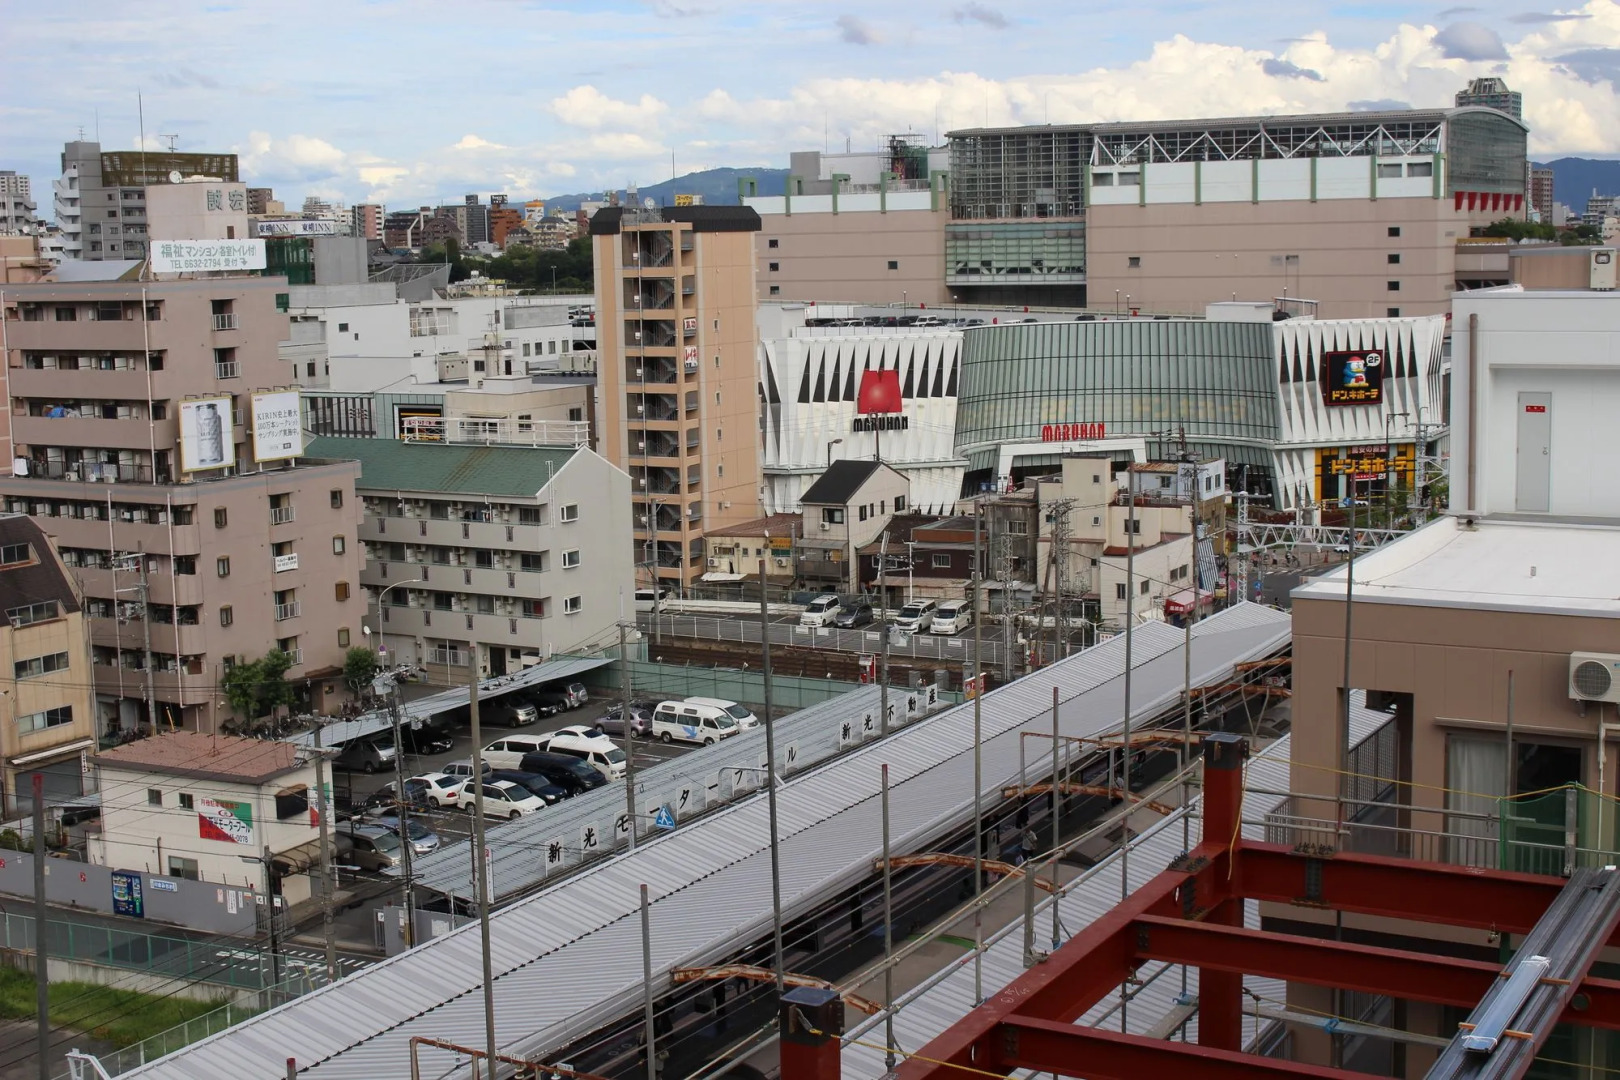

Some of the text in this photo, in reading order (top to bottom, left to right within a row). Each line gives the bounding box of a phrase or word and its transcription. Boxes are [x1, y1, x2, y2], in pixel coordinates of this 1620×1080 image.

[302, 222, 331, 232] 東横INN
[170, 259, 182, 268] TEL
[1368, 356, 1380, 364] 2F
[853, 416, 908, 432] MARUHAN
[1042, 422, 1105, 442] MARUHAN
